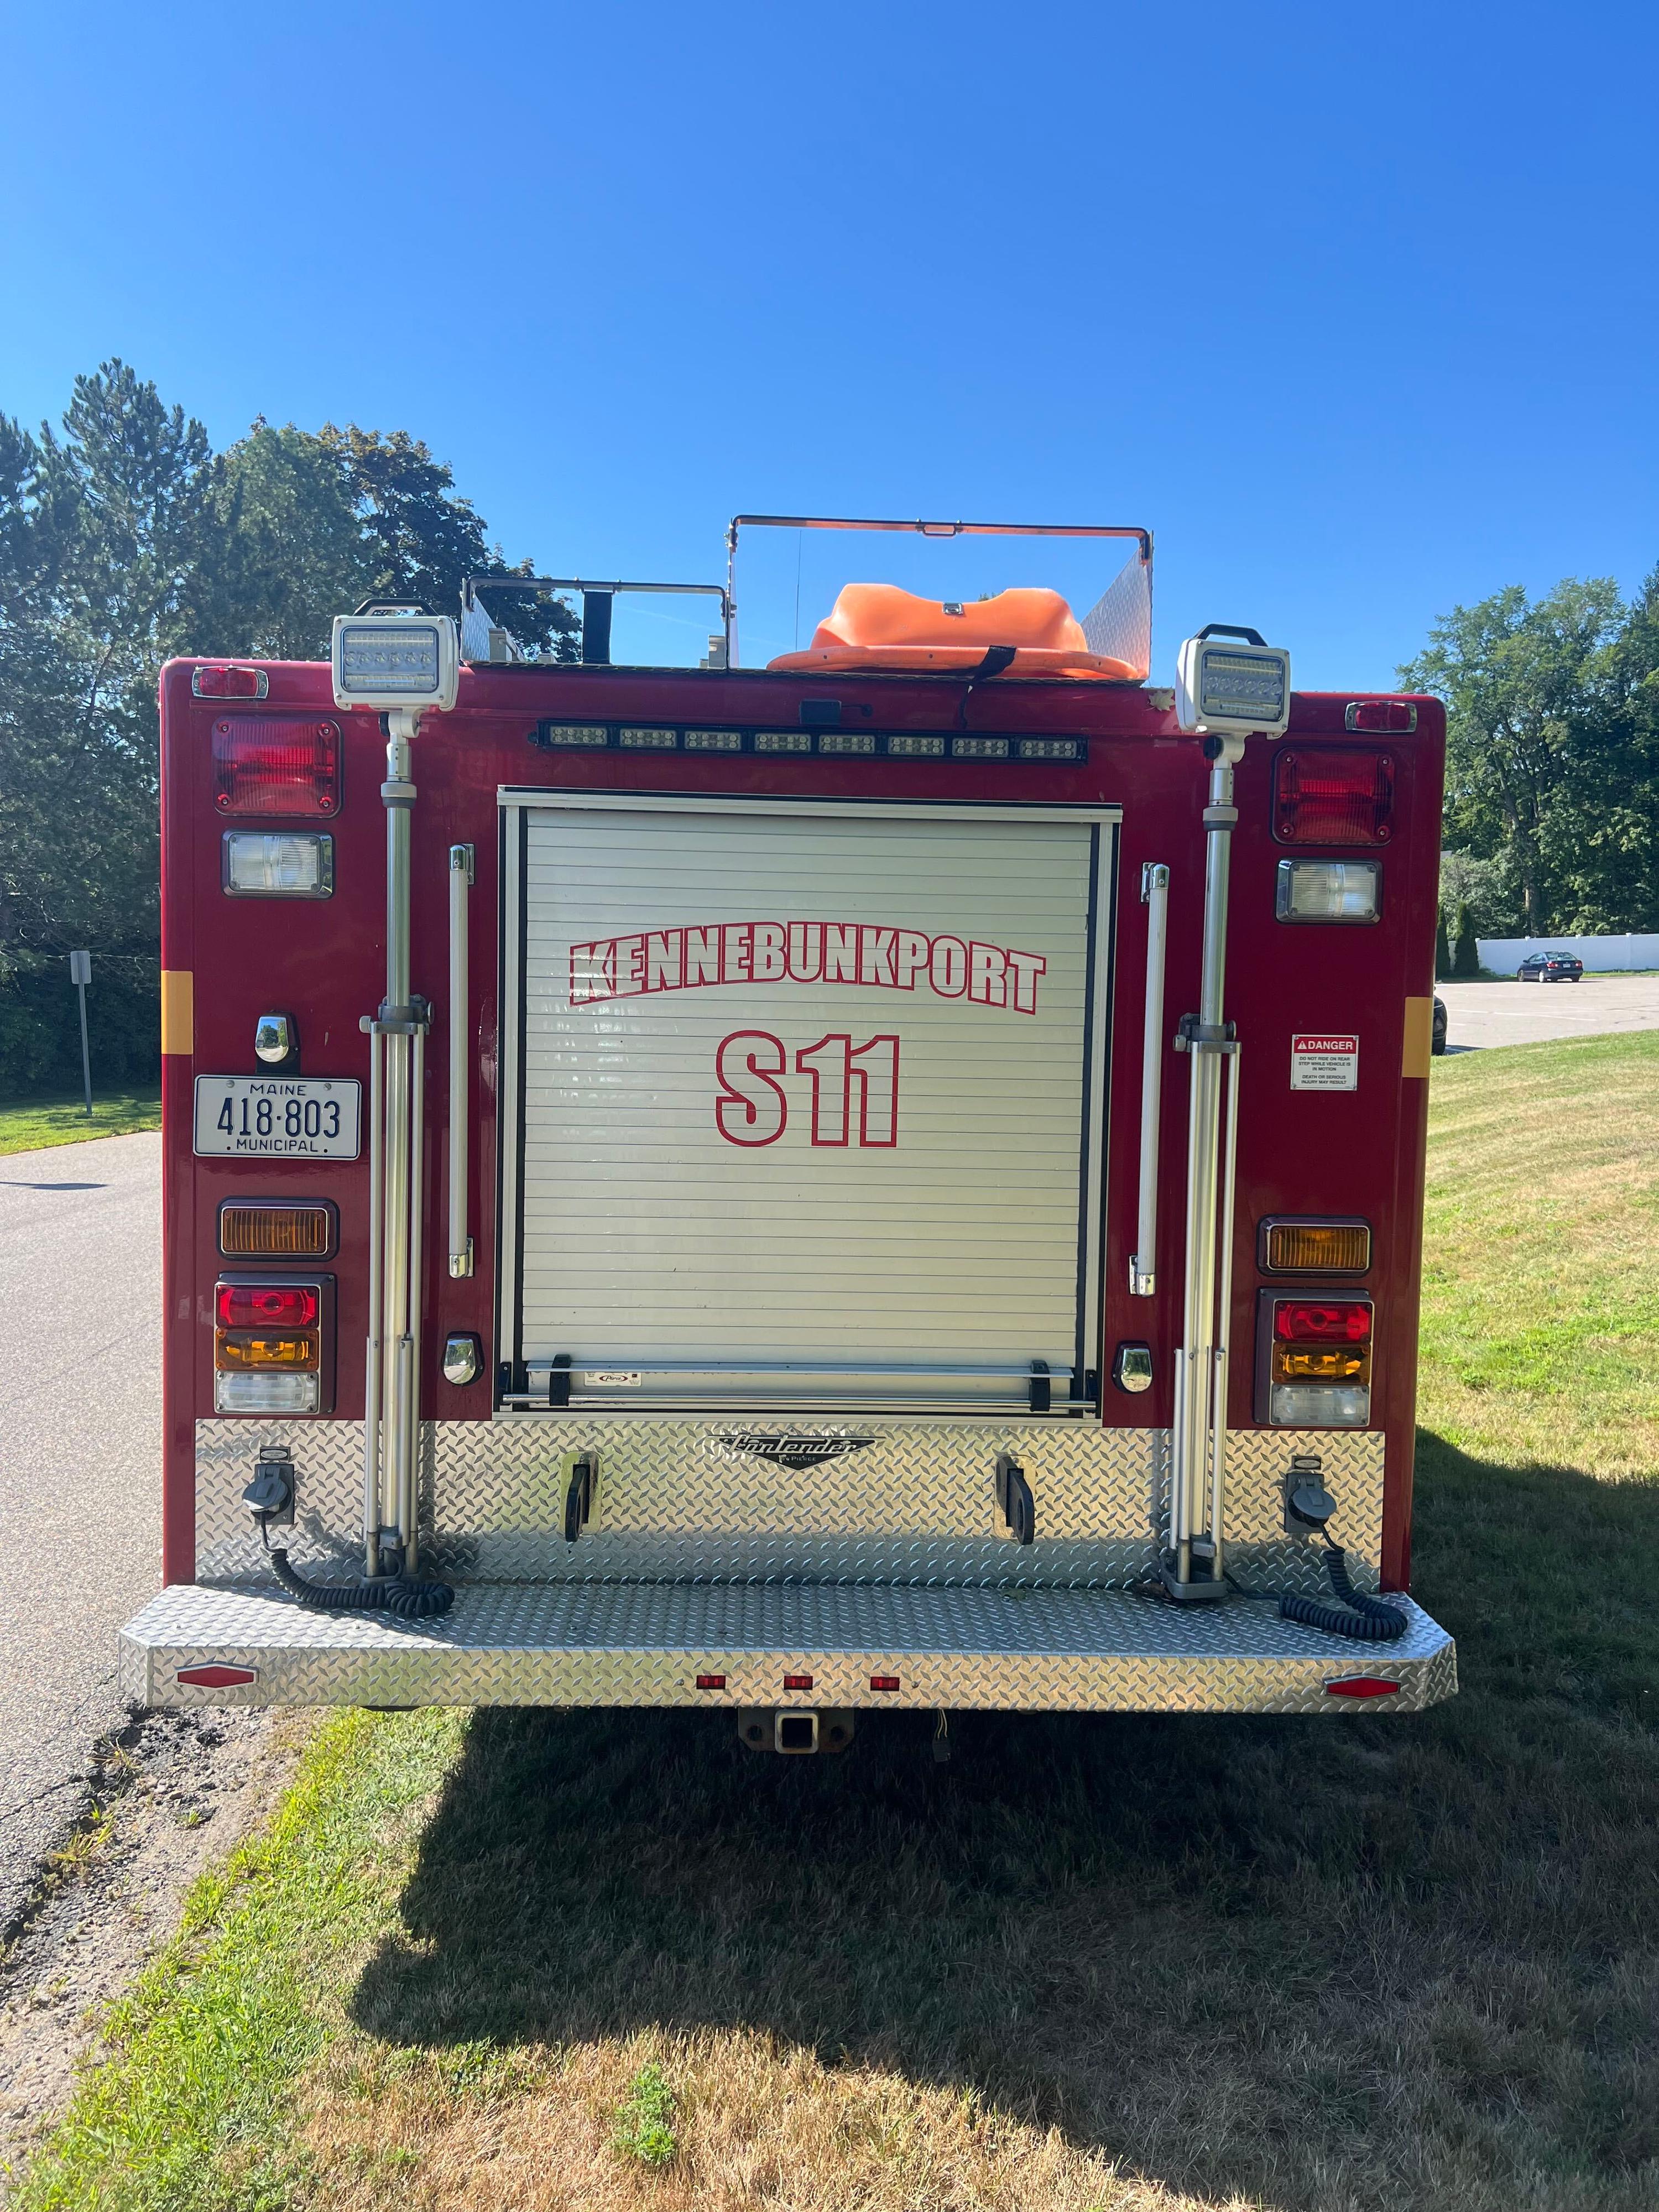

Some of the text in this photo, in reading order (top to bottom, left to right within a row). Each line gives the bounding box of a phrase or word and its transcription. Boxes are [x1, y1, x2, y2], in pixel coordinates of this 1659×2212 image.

[570, 921, 1046, 1015] KENNEBUNKPORT
[1308, 1041, 1353, 1050] DANGER
[249, 1084, 307, 1096] MAINE
[716, 1030, 900, 1147] S11
[236, 1139, 318, 1152] MUNICIPAL
[729, 1433, 860, 1454] Contender
